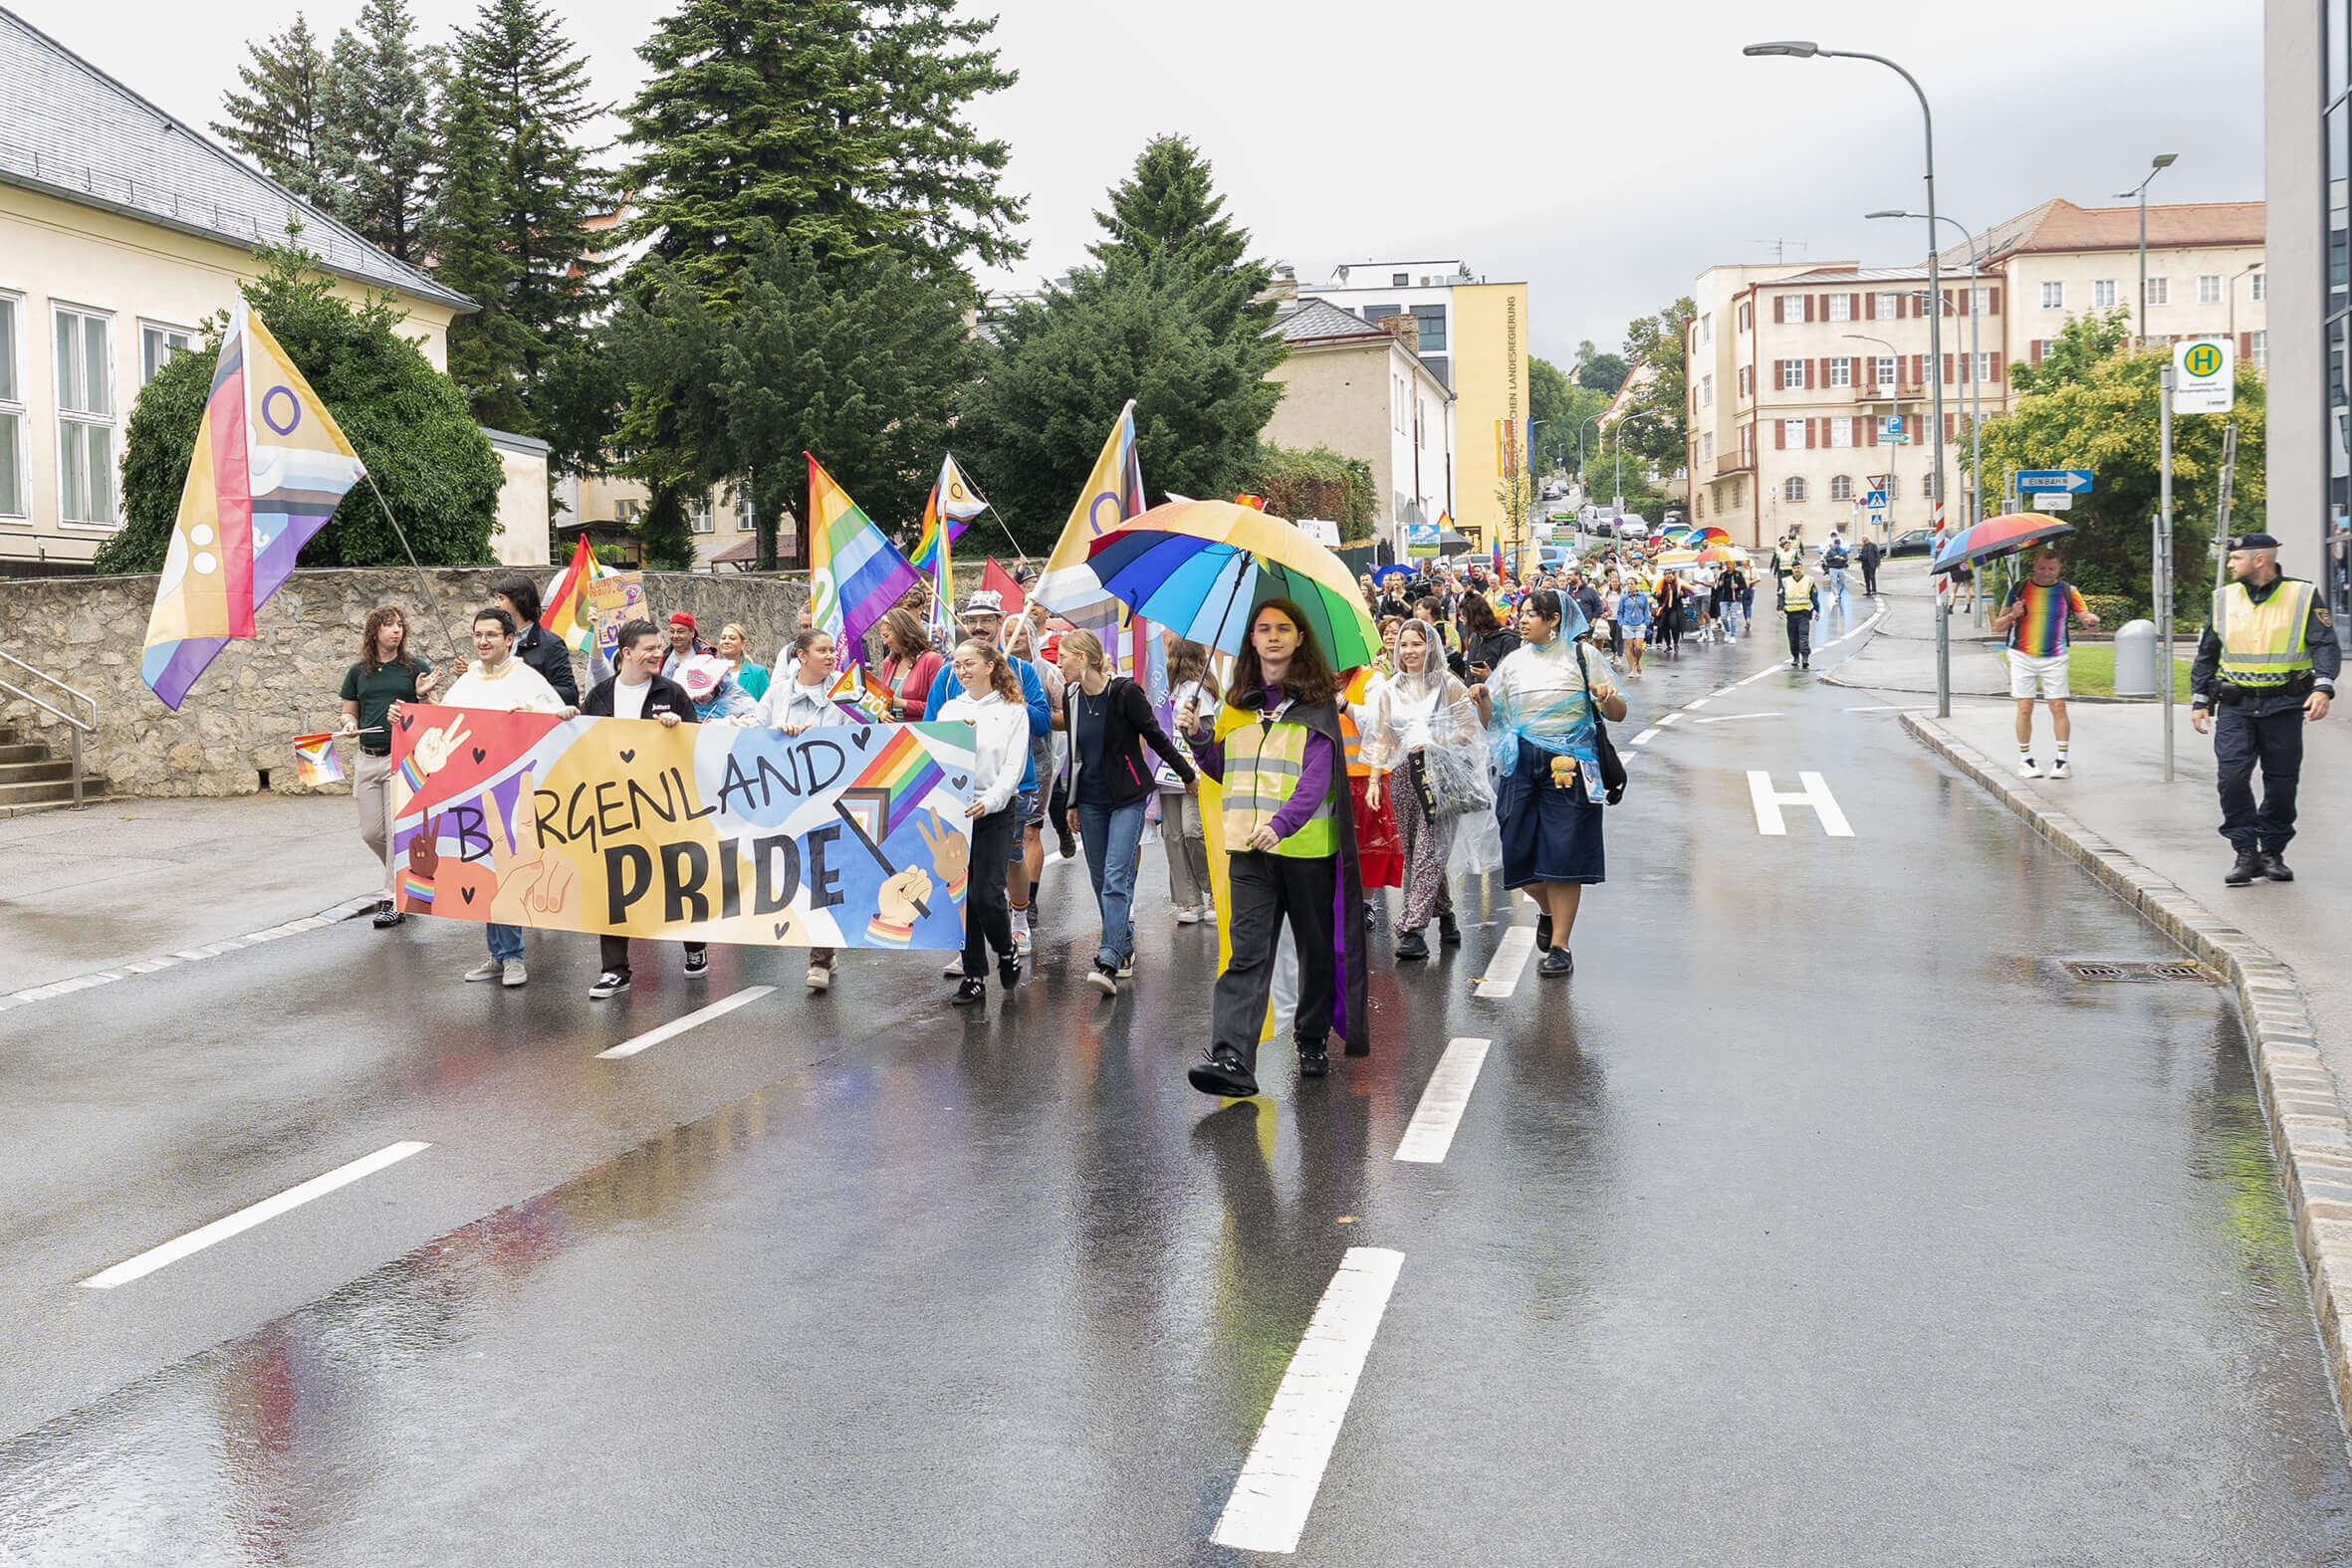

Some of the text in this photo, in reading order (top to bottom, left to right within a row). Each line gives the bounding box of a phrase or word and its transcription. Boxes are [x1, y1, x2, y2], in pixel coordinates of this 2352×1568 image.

[1507, 296, 1518, 390] LANDESREGIERUNG
[2194, 349, 2213, 371] H
[1746, 771, 1855, 836] H
[603, 824, 844, 926] PRIDE
